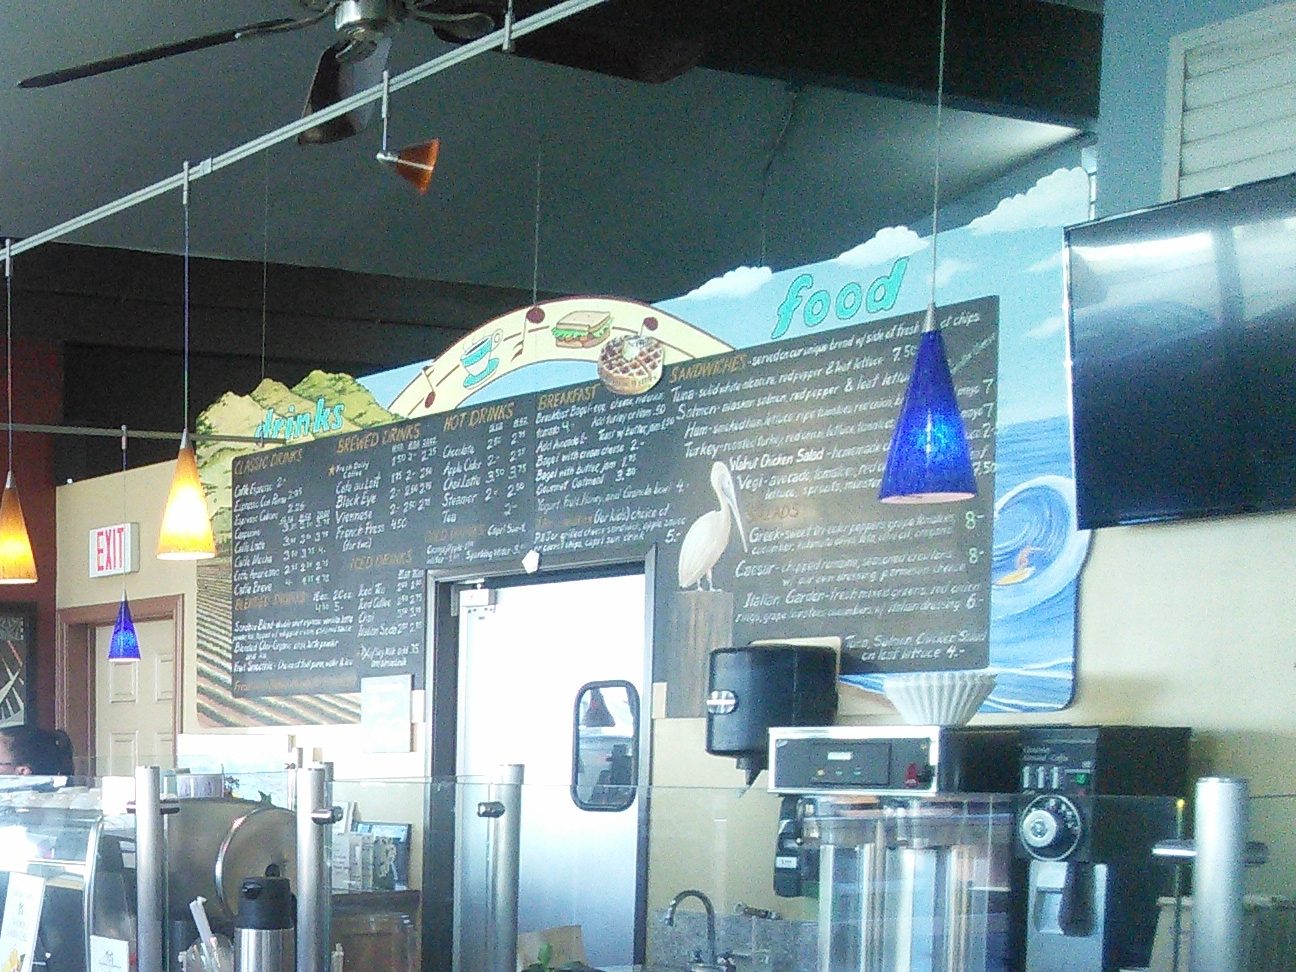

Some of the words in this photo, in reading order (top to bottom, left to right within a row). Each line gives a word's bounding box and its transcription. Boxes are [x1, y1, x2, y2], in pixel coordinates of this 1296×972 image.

[771, 256, 910, 339] food
[670, 354, 748, 384] SANDWICHES
[953, 311, 981, 326] chips
[805, 386, 840, 400] pepper
[843, 378, 853, 392] &
[856, 374, 879, 390] leaf
[983, 378, 994, 394] 7
[537, 382, 601, 411] BREAKFAST
[255, 398, 345, 441] drinks
[443, 410, 467, 433] HOT
[467, 402, 515, 428] DRINKS
[983, 402, 995, 418] 7
[336, 431, 379, 454] BREWED
[382, 423, 422, 446] DRINKS
[536, 440, 553, 454] Add
[234, 455, 269, 476] CLASSIC
[535, 454, 559, 469] Bagel
[561, 450, 579, 463] with
[761, 453, 793, 469] Chicken
[796, 447, 825, 463] Salad
[535, 468, 557, 483] Bagel
[559, 466, 574, 478] with
[571, 474, 605, 489] Oatmeal
[336, 494, 361, 509] Black
[360, 491, 377, 507] Eye
[442, 492, 479, 508] Steamer
[335, 510, 373, 525] Viennese
[442, 509, 457, 524] Tea
[630, 505, 657, 521] choice
[335, 525, 364, 540] French
[364, 521, 385, 536] Press
[97, 527, 124, 571] EXIT
[901, 647, 941, 660] lettuce
